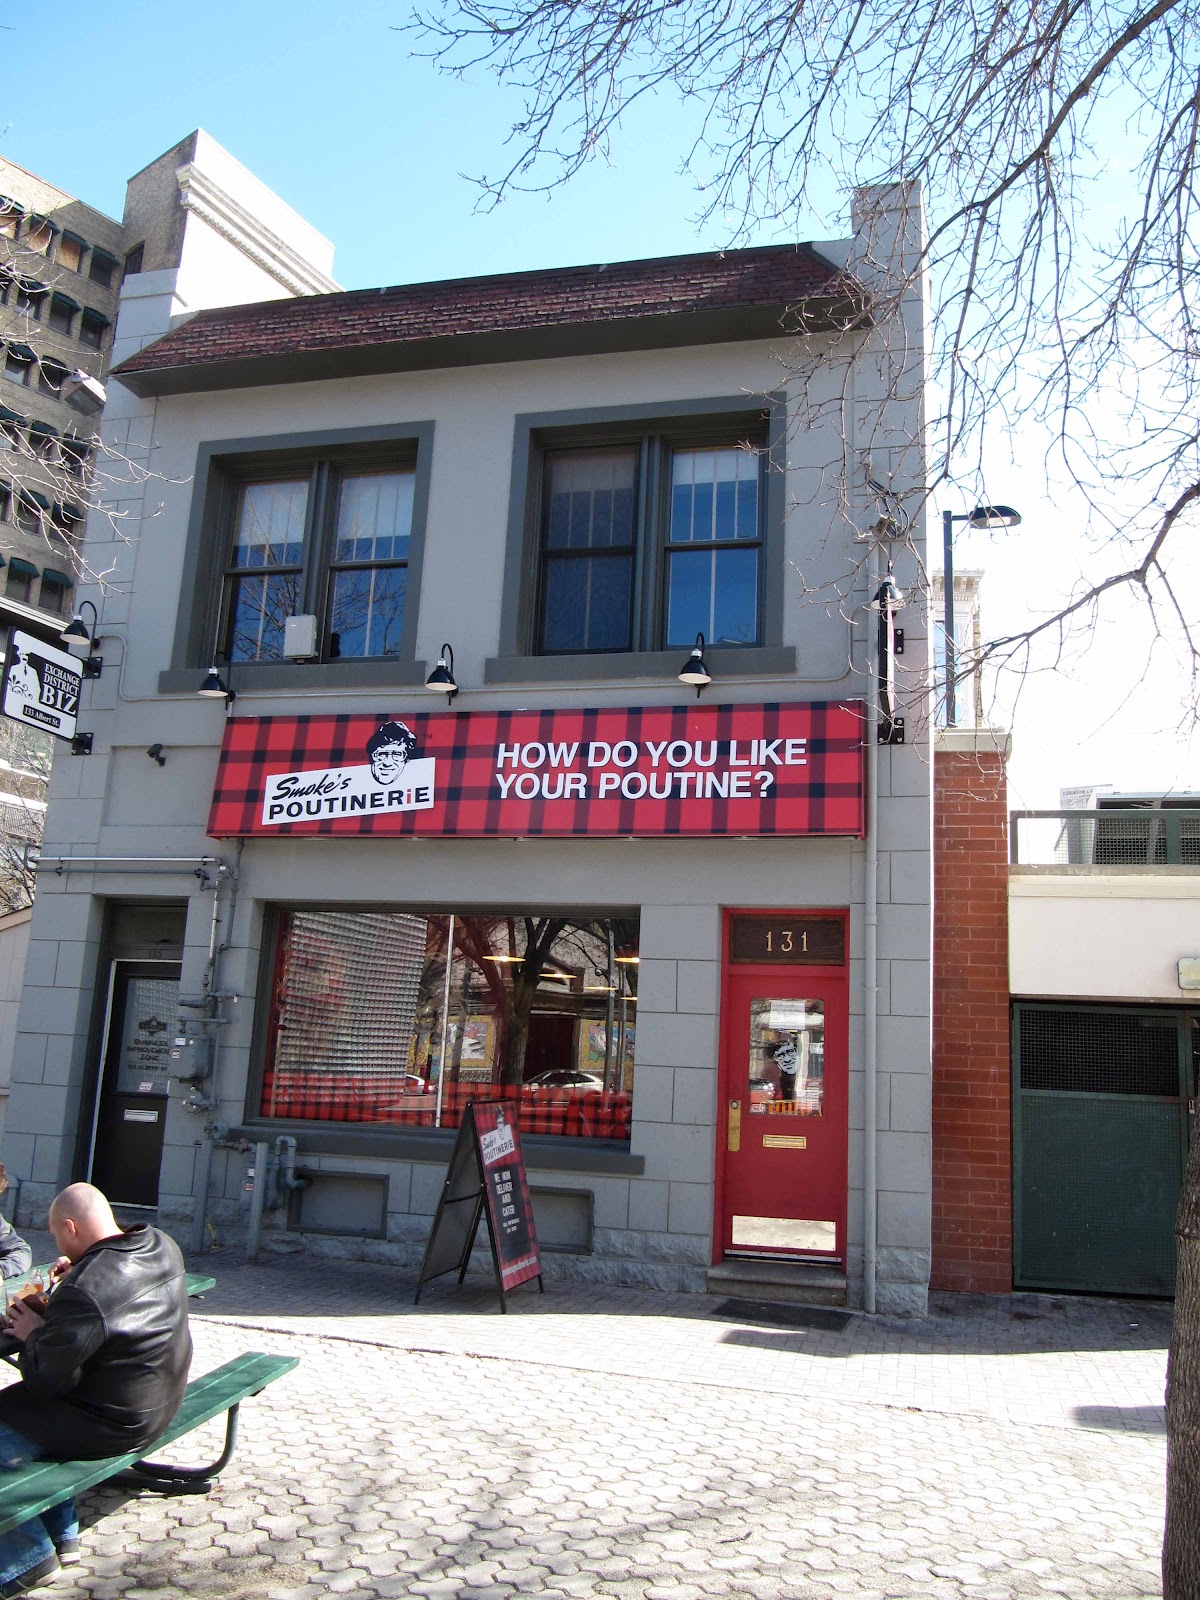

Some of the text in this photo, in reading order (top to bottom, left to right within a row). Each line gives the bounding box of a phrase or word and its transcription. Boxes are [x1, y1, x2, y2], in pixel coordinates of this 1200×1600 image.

[44, 673, 79, 696] DISTRICT
[45, 663, 80, 687] EXCHANGE
[40, 683, 77, 715] BIZ
[25, 707, 34, 717] 133
[35, 711, 51, 723] Albert
[497, 738, 807, 769] HOW DO YOU LIKE
[271, 773, 352, 801] Smoke's
[495, 770, 774, 800] YOUR POUTINE?
[766, 931, 808, 952] 131
[127, 1046, 170, 1055] IMPROVEMEN
[134, 1039, 168, 1047] BUSINESS
